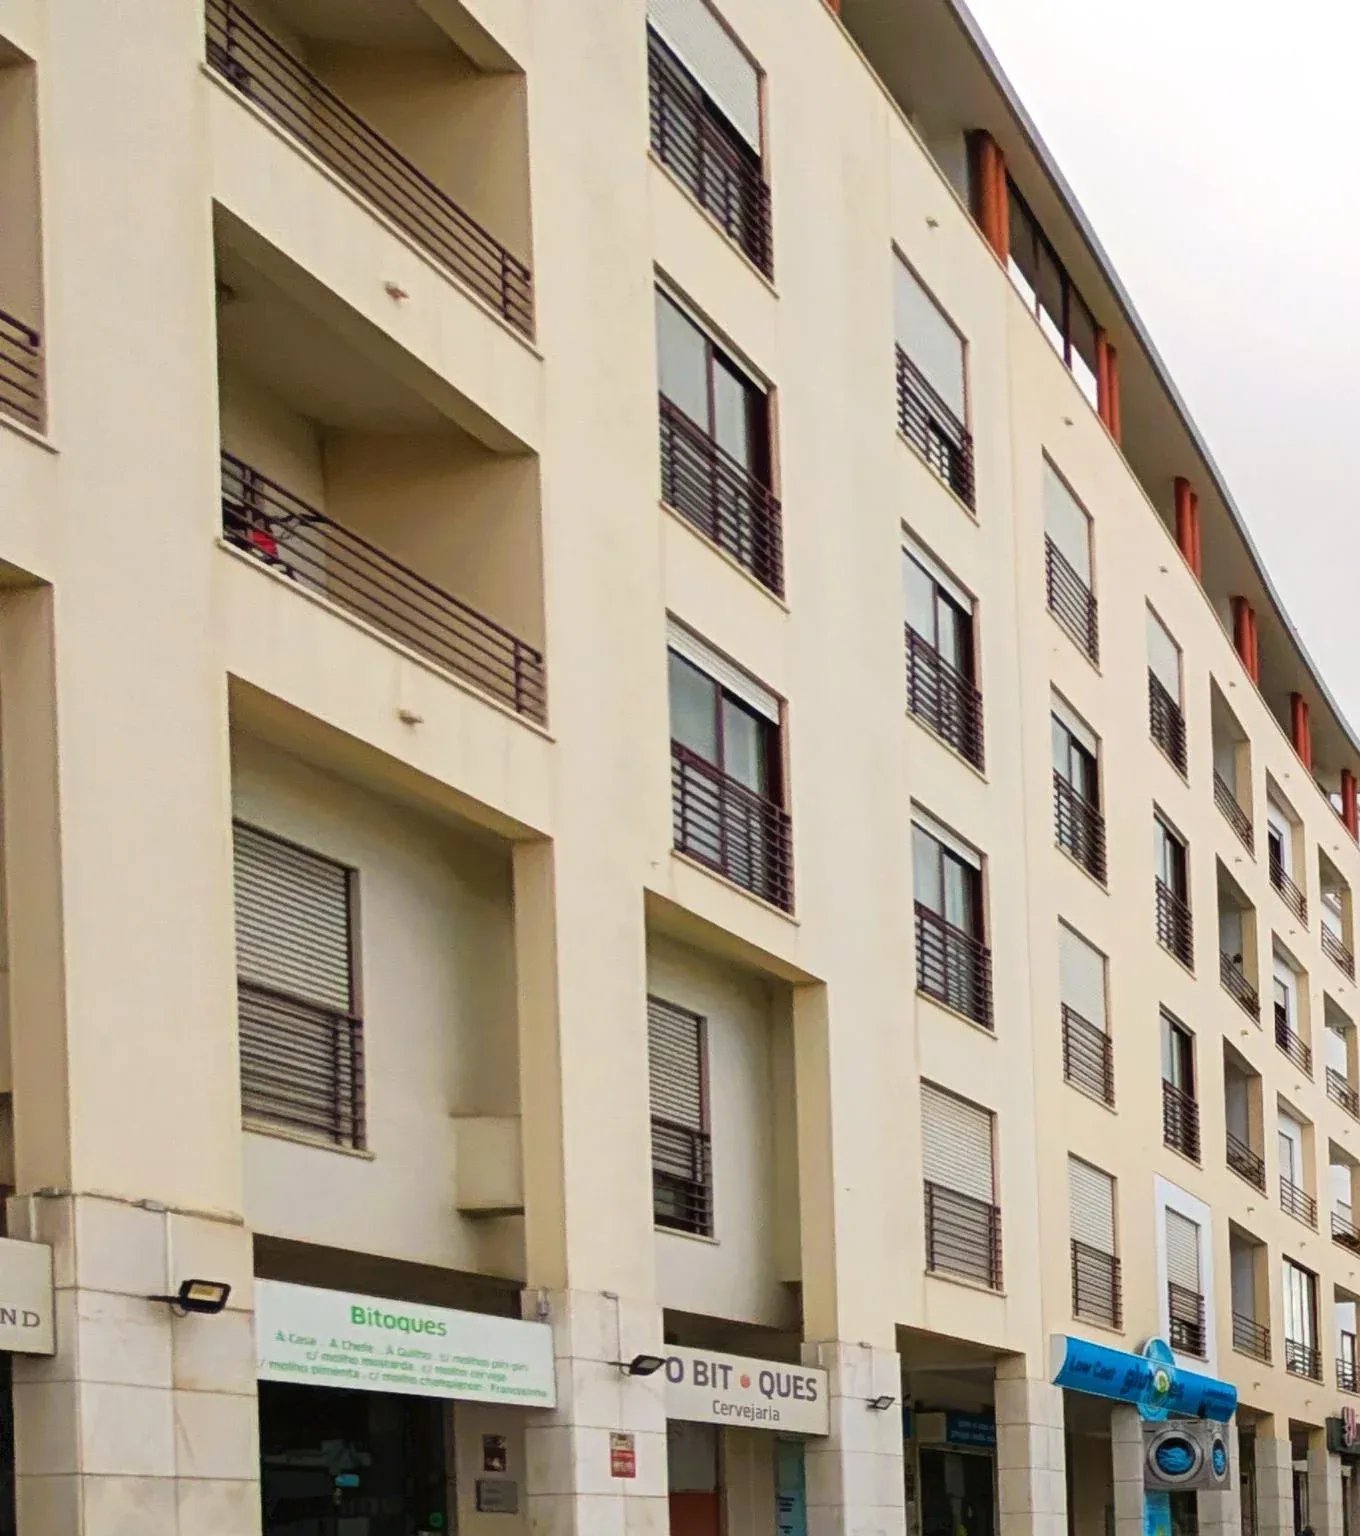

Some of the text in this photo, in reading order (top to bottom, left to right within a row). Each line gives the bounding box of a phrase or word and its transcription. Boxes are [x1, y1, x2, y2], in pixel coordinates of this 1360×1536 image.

[351, 1305, 448, 1337] Bitoques
[665, 1356, 684, 1384] O
[712, 1400, 780, 1422] Cervejaria
